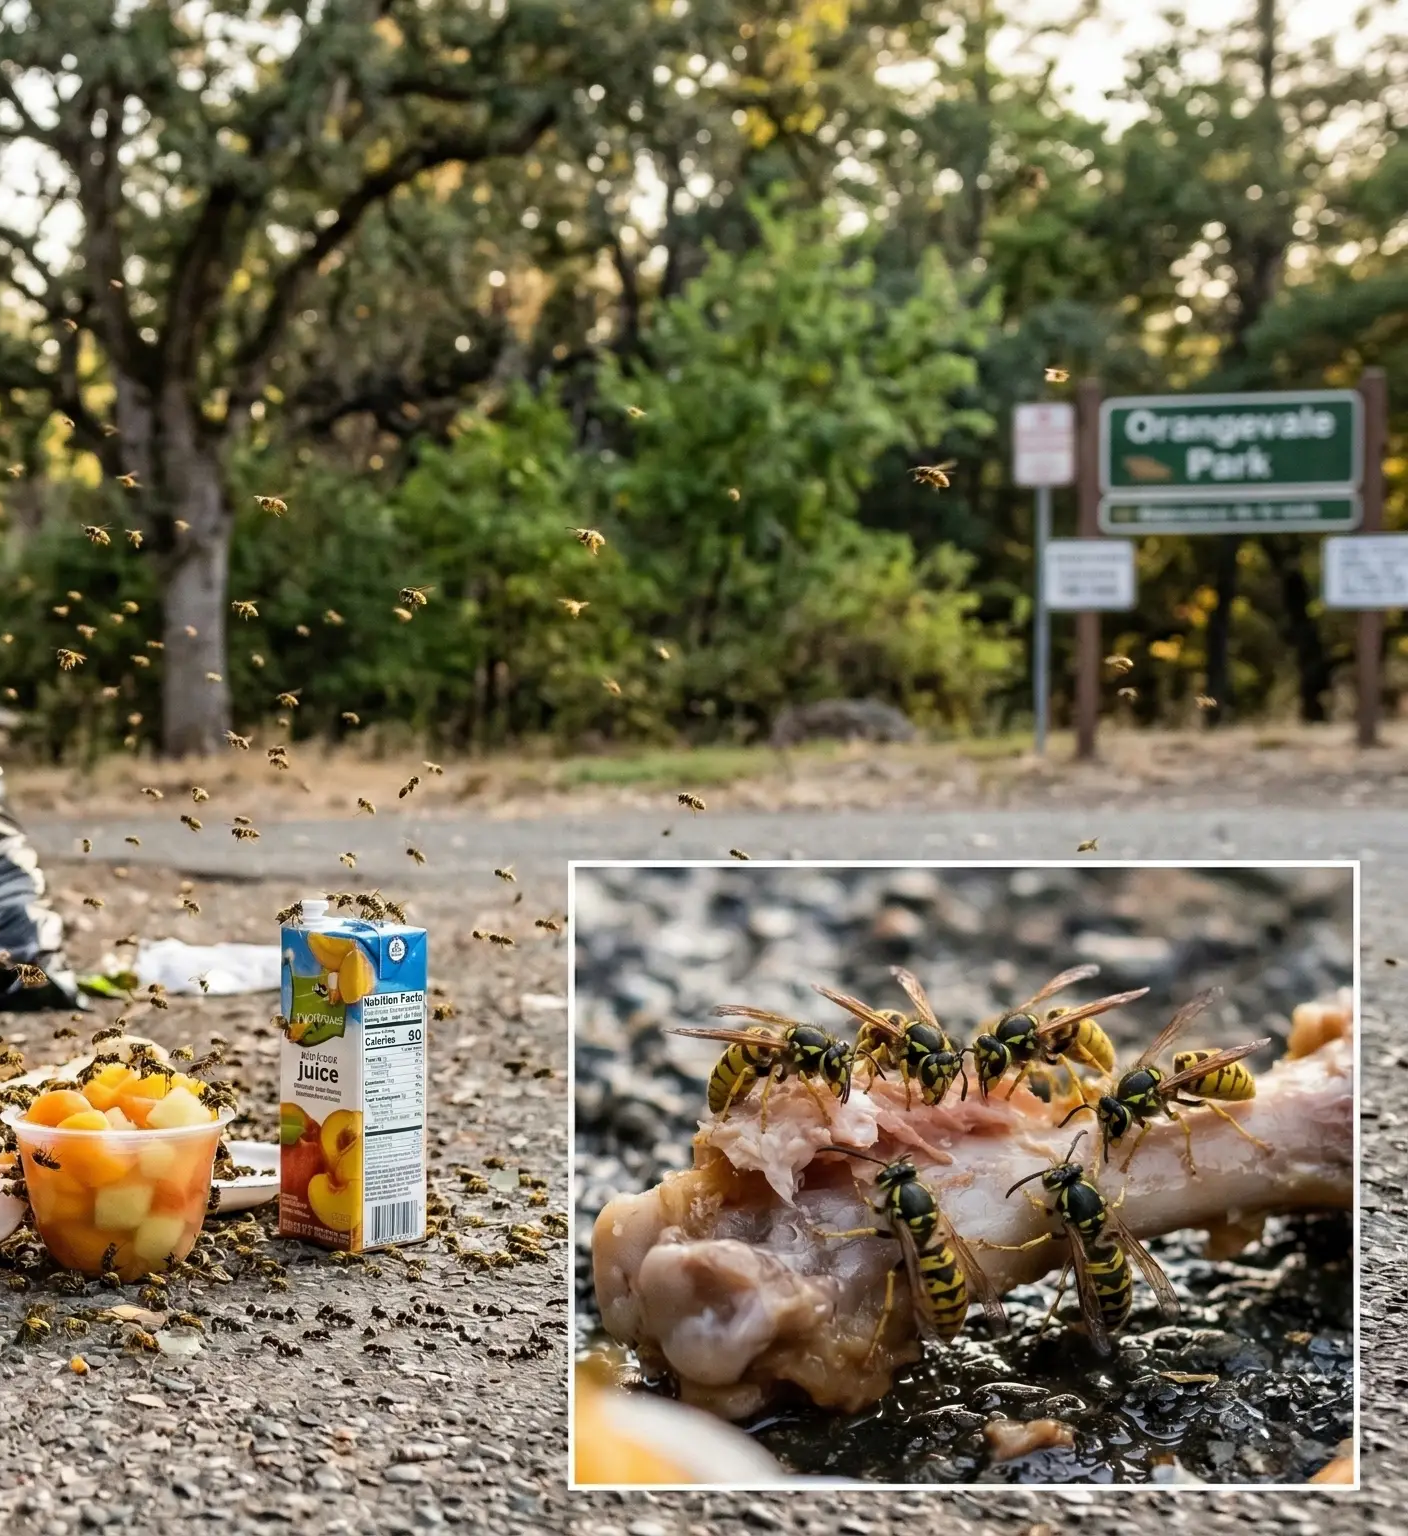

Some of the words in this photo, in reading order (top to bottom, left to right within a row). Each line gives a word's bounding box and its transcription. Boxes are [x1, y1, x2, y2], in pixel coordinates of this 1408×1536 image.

[1124, 405, 1337, 449] Orangevale
[1185, 445, 1273, 481] Park
[297, 1061, 339, 1083] juice
